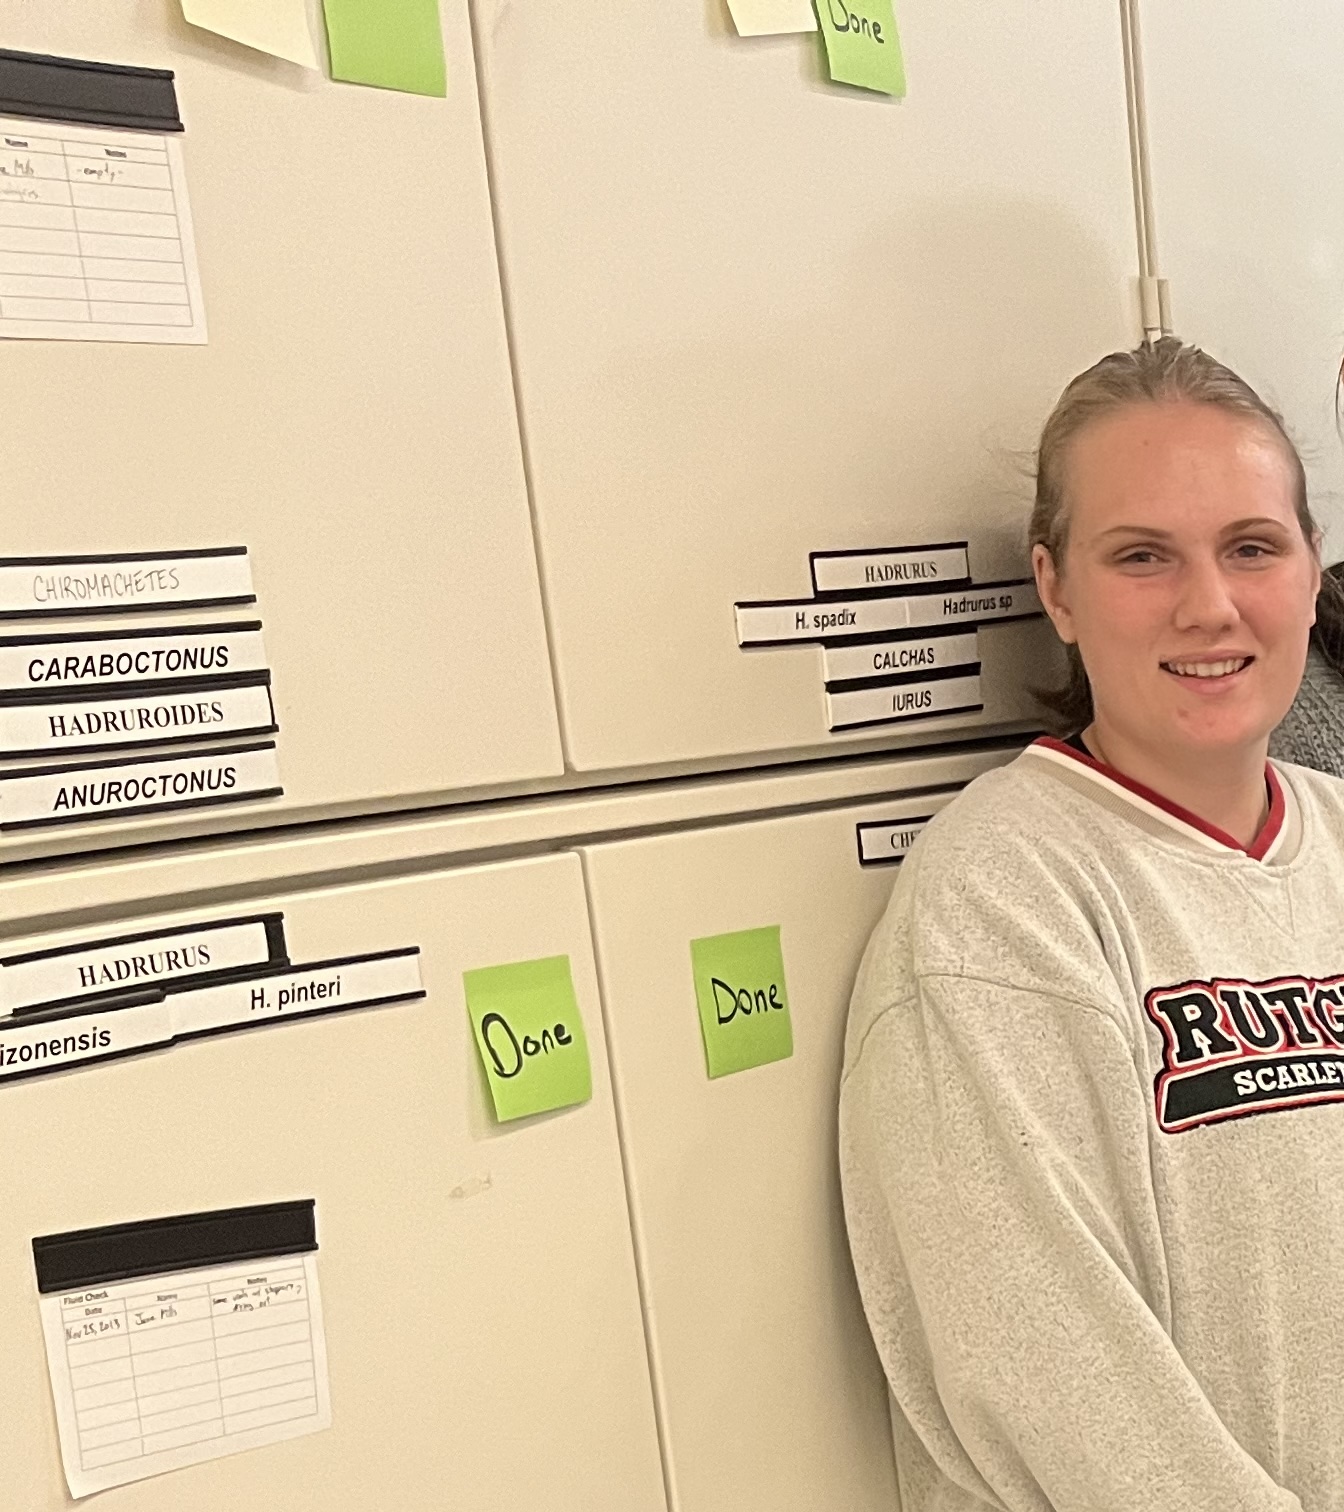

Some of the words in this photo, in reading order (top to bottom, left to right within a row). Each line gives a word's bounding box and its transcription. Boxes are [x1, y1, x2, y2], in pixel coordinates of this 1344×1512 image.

[33, 568, 180, 602] CHIROMACHETES
[865, 561, 938, 583] HADRURUS
[795, 612, 810, 629] H.
[814, 608, 856, 631] spadix
[943, 596, 996, 616] Hadrurus
[999, 594, 1013, 611] sp
[28, 646, 229, 682] CARABOCTONUS
[873, 648, 935, 670] CALCHAS
[48, 701, 224, 738] HADRUROIDES
[892, 690, 932, 712] IURUS
[53, 767, 236, 811] ANUROCTONUS
[77, 944, 211, 987] HADRURUS
[250, 988, 271, 1010] H.
[278, 976, 341, 1011] pinteri
[711, 977, 784, 1025] Done
[0, 1026, 111, 1066] izonensis
[481, 1012, 572, 1078] Done
